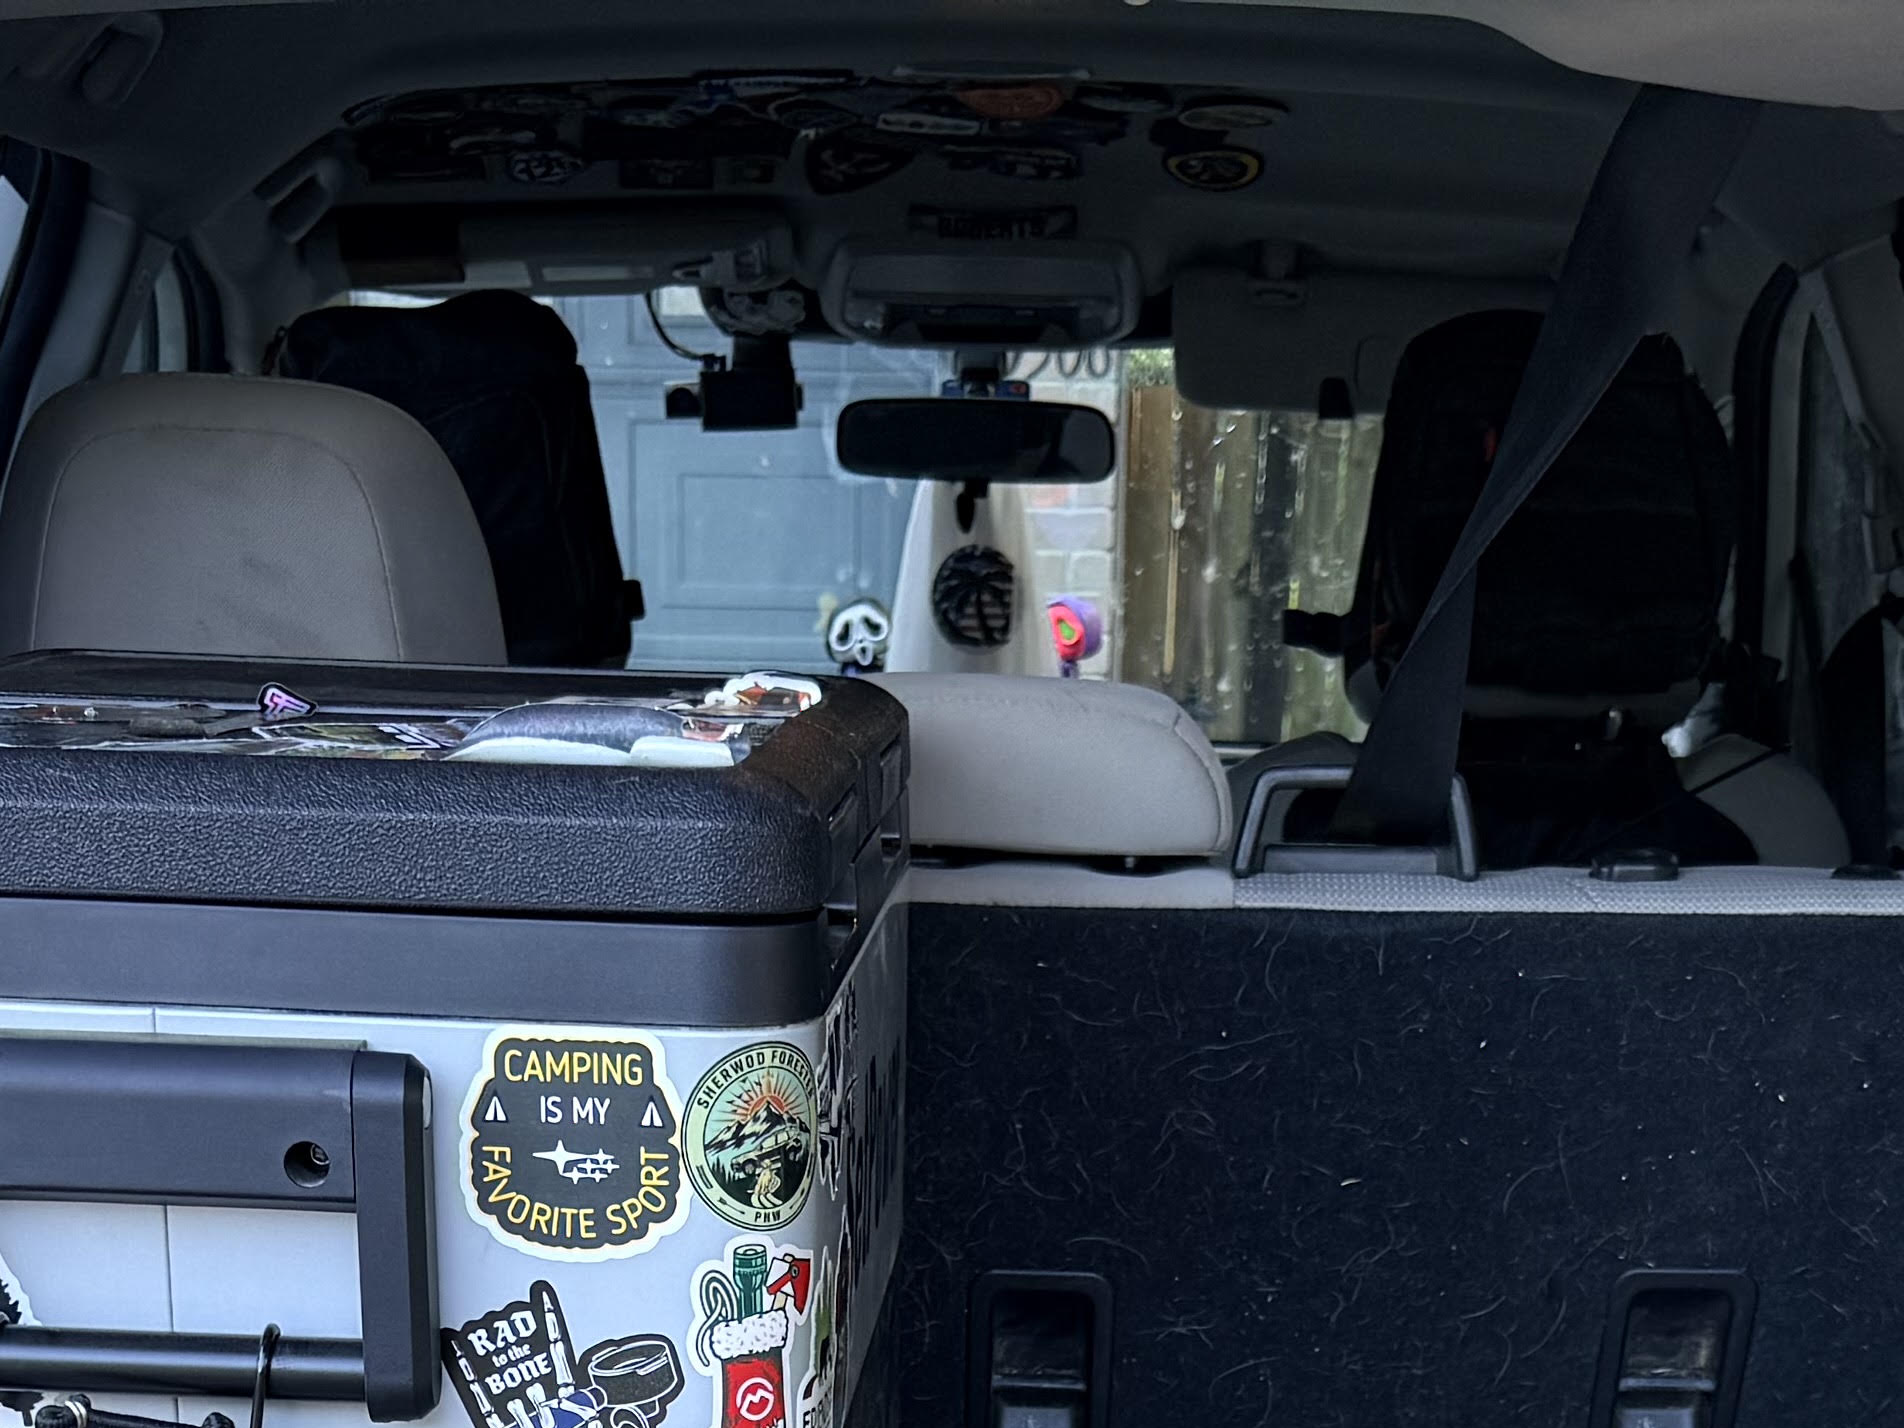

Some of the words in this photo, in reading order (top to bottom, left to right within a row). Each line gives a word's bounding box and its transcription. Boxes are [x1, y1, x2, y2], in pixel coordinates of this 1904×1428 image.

[503, 1048, 643, 1085] CAMPING
[539, 1098, 564, 1123] IS
[571, 1099, 610, 1126] MY
[481, 1146, 598, 1239] FAVORITE
[606, 1146, 669, 1234] SPORT
[467, 1310, 537, 1356] RAD
[484, 1352, 552, 1395] BONE
[492, 1354, 508, 1367] to
[507, 1344, 531, 1362] the
